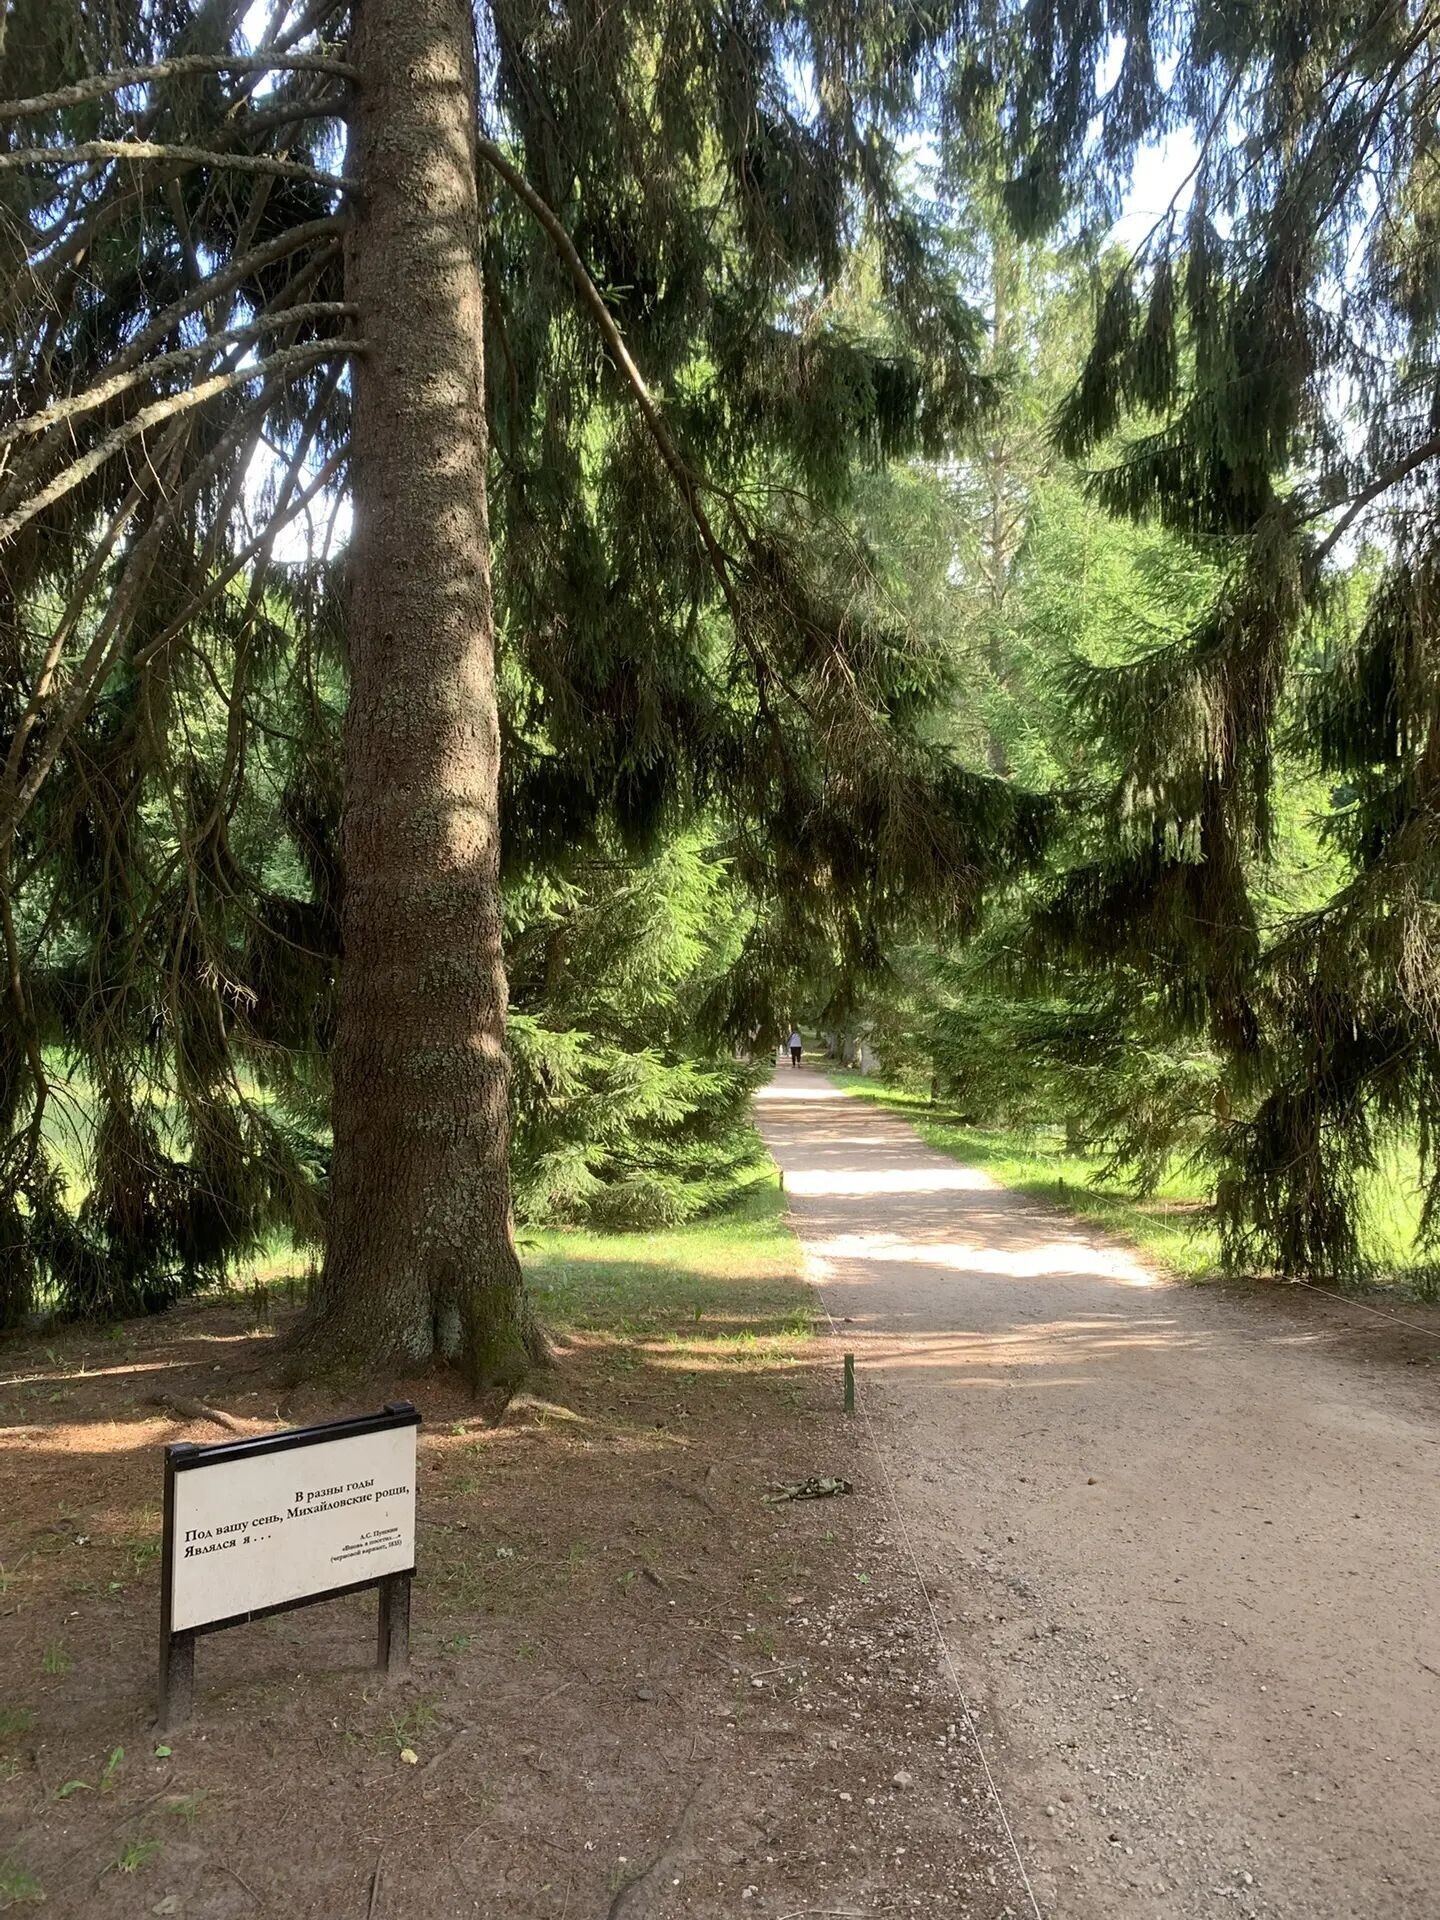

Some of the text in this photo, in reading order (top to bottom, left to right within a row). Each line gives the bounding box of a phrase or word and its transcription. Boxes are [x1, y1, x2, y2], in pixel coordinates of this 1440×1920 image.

[295, 1479, 375, 1503] В разны годы
[184, 1529, 214, 1543] Под
[216, 1521, 249, 1533] вашу
[252, 1514, 284, 1527] сень,
[286, 1493, 373, 1519] Михайловские
[184, 1539, 237, 1559] Являлся
